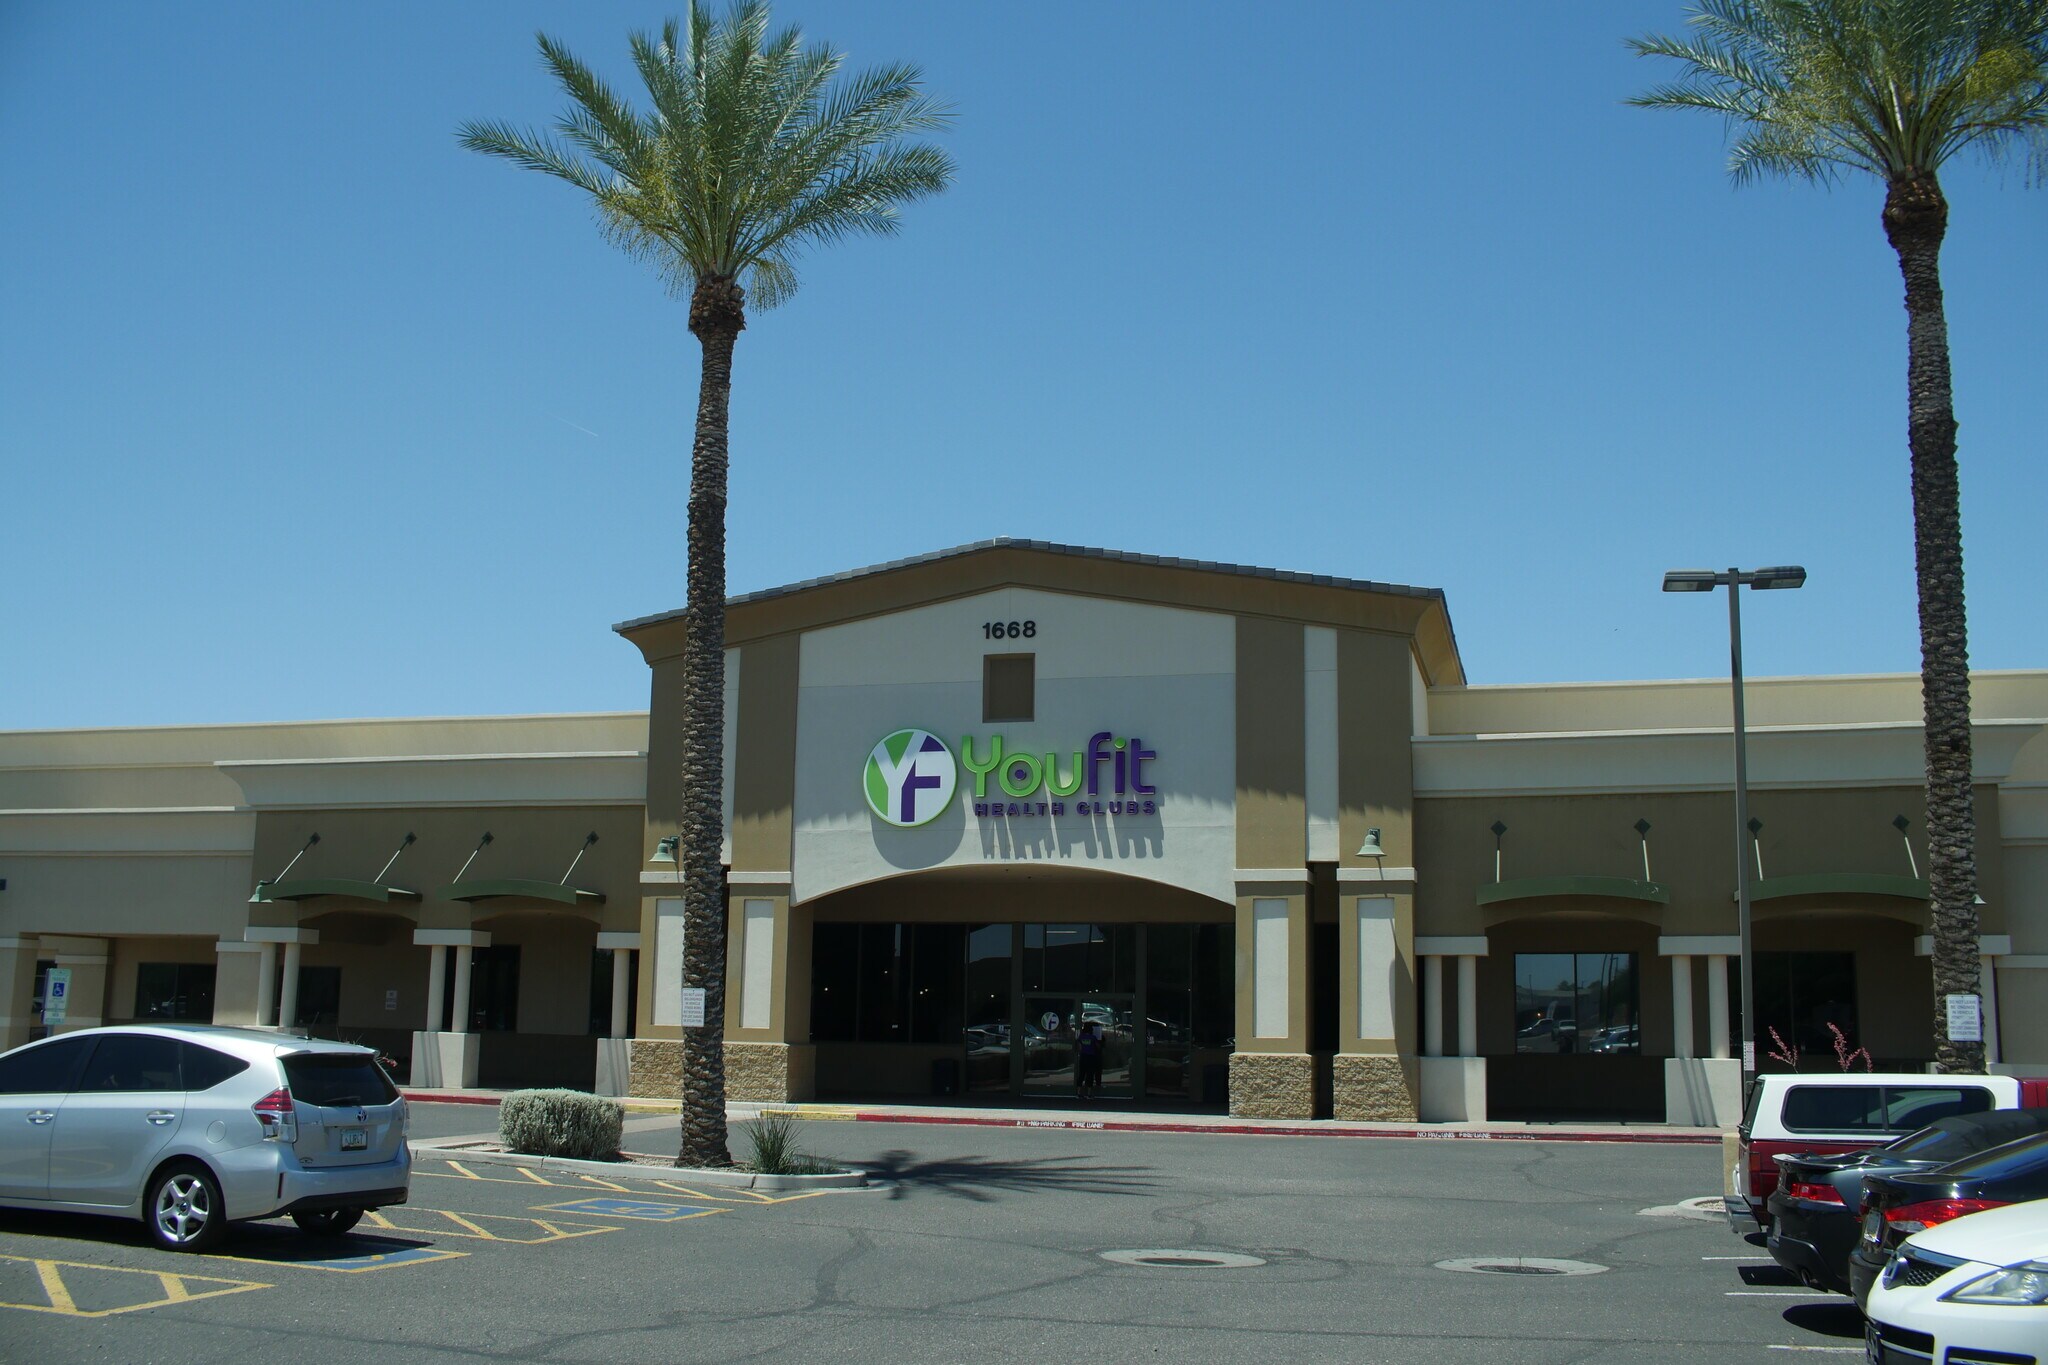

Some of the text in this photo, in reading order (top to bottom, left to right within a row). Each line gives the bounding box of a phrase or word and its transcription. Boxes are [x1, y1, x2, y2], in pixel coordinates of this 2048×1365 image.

[982, 620, 1036, 639] 1668
[962, 731, 1156, 797] Youfit
[975, 800, 1156, 816] HEALTH CLUBS
